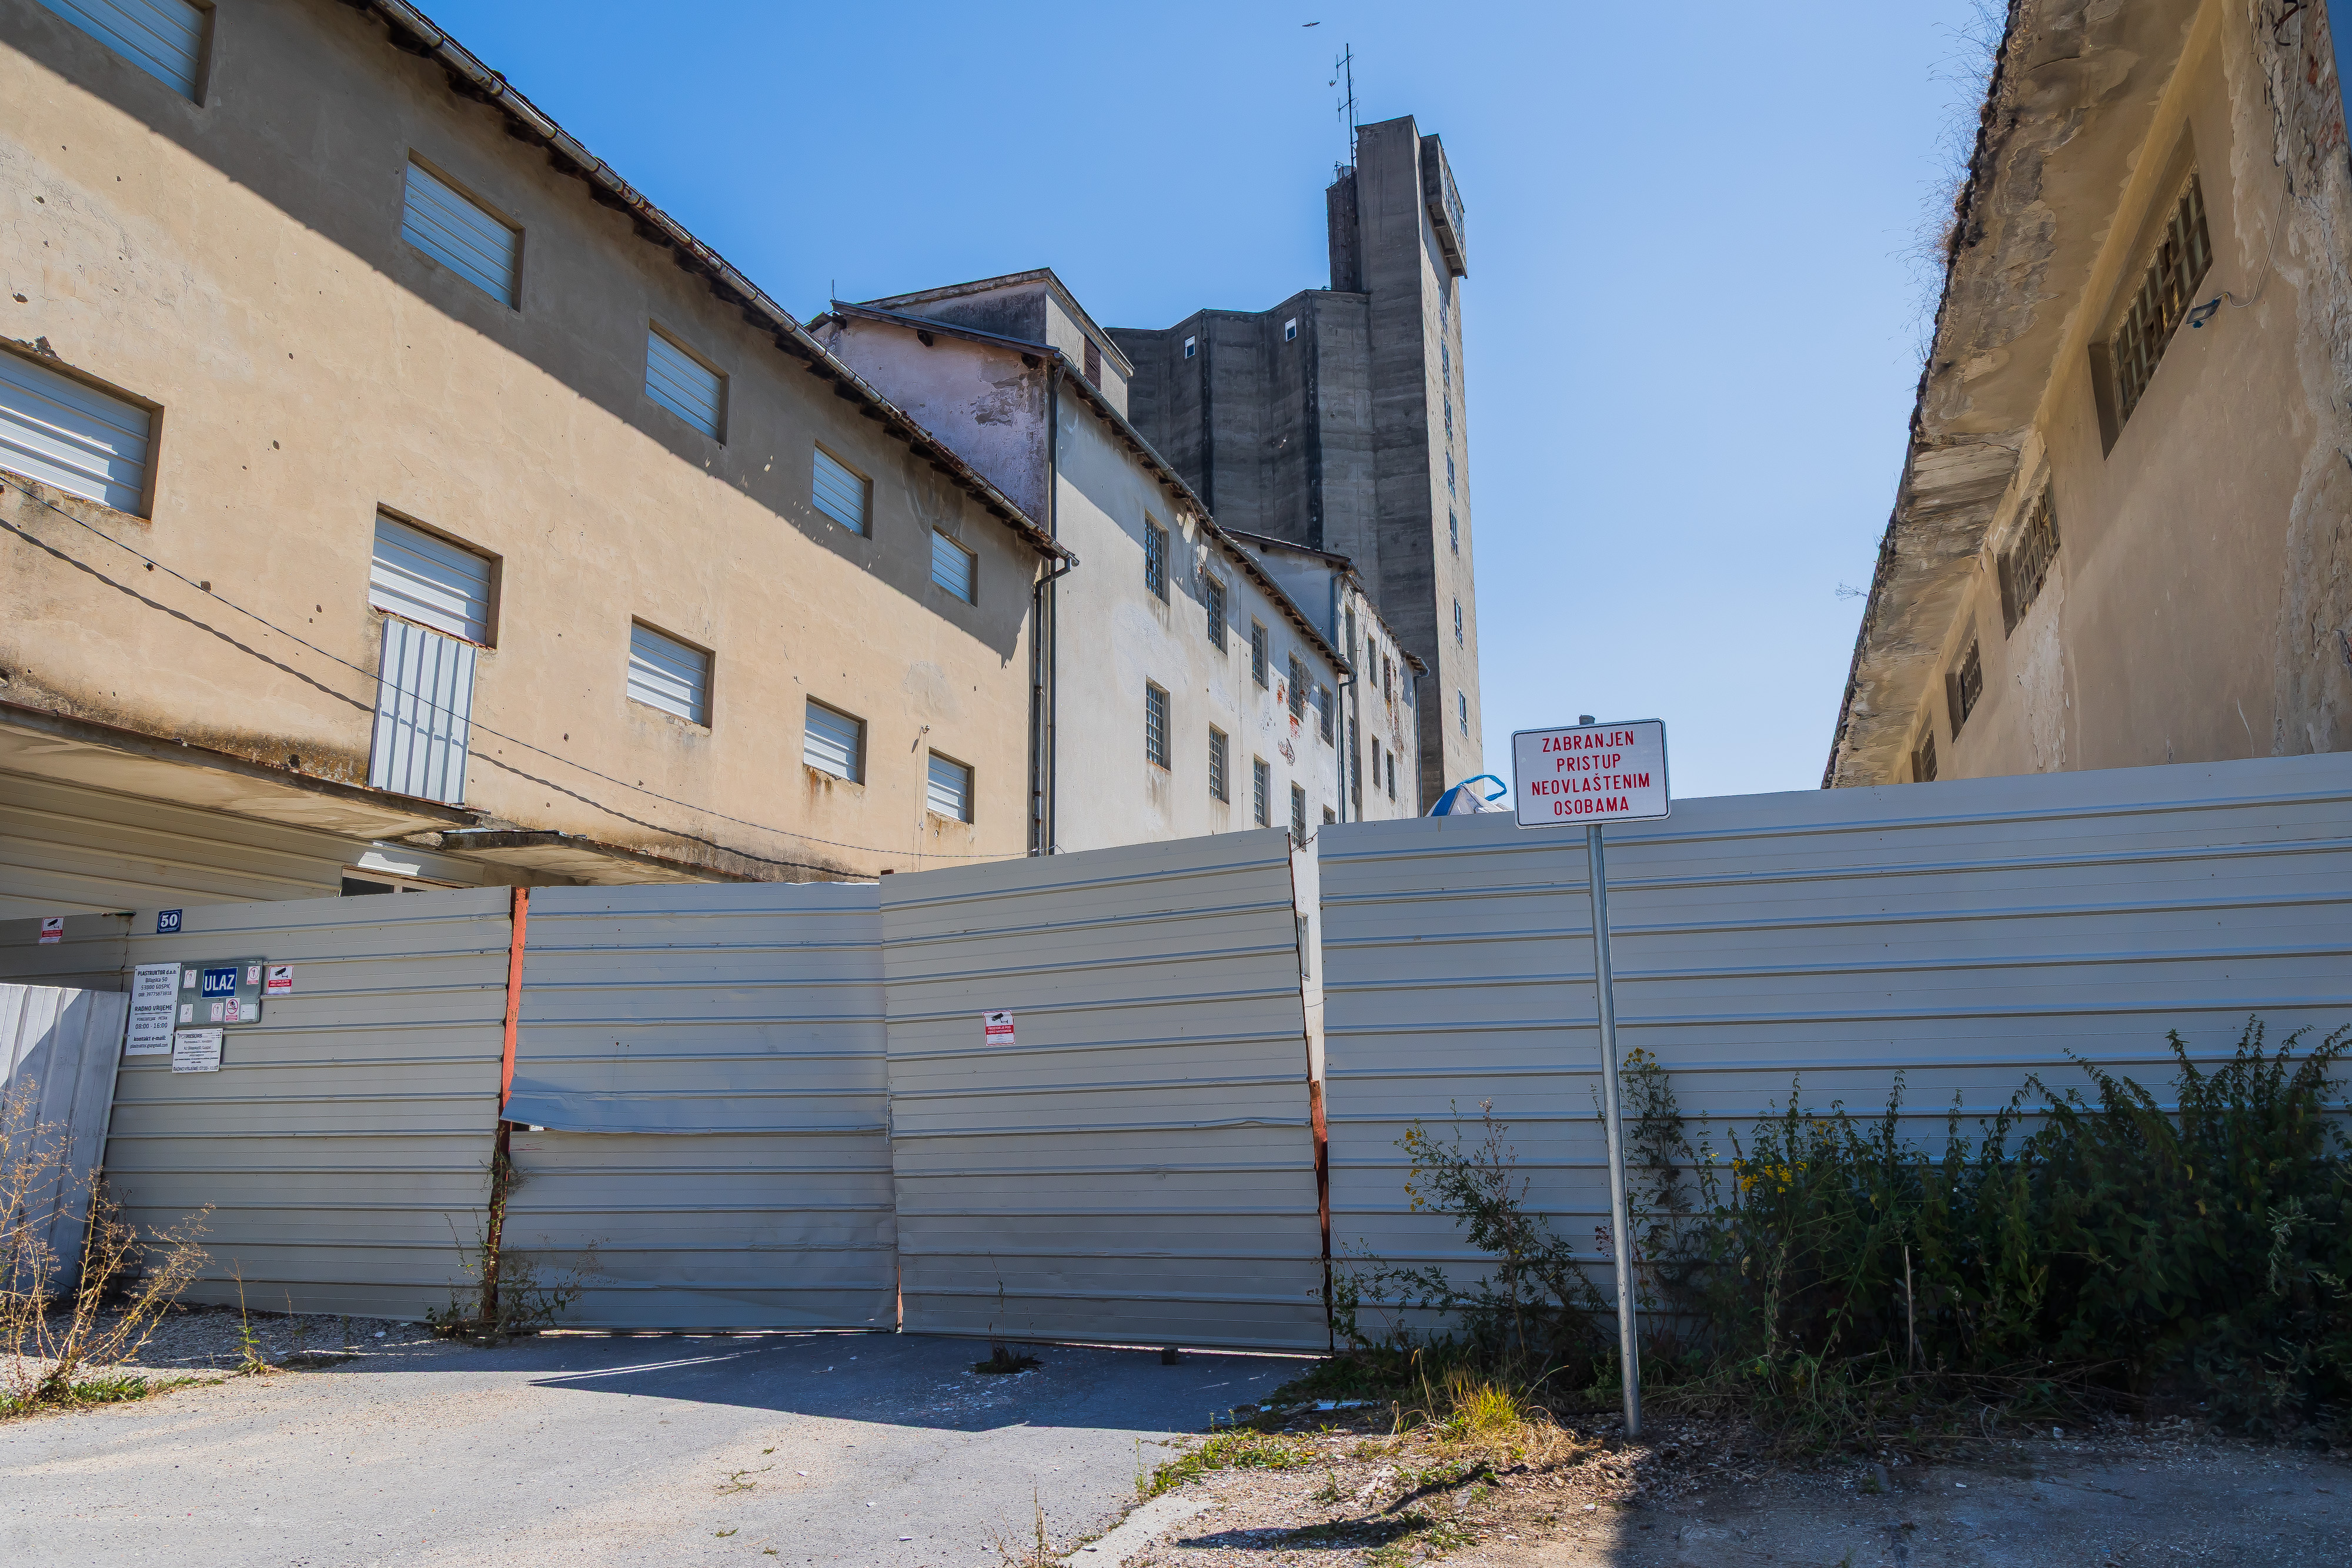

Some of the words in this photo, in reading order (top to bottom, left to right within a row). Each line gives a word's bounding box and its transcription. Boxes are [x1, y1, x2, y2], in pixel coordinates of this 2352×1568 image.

[1542, 730, 1634, 753] ZABRANJEN
[1556, 753, 1621, 773] PRISTUP
[1531, 773, 1650, 796] NEOVLAŠTENIM
[1553, 796, 1629, 816] OSOBAMA
[161, 914, 178, 927] 50
[204, 974, 235, 991] ULAZ
